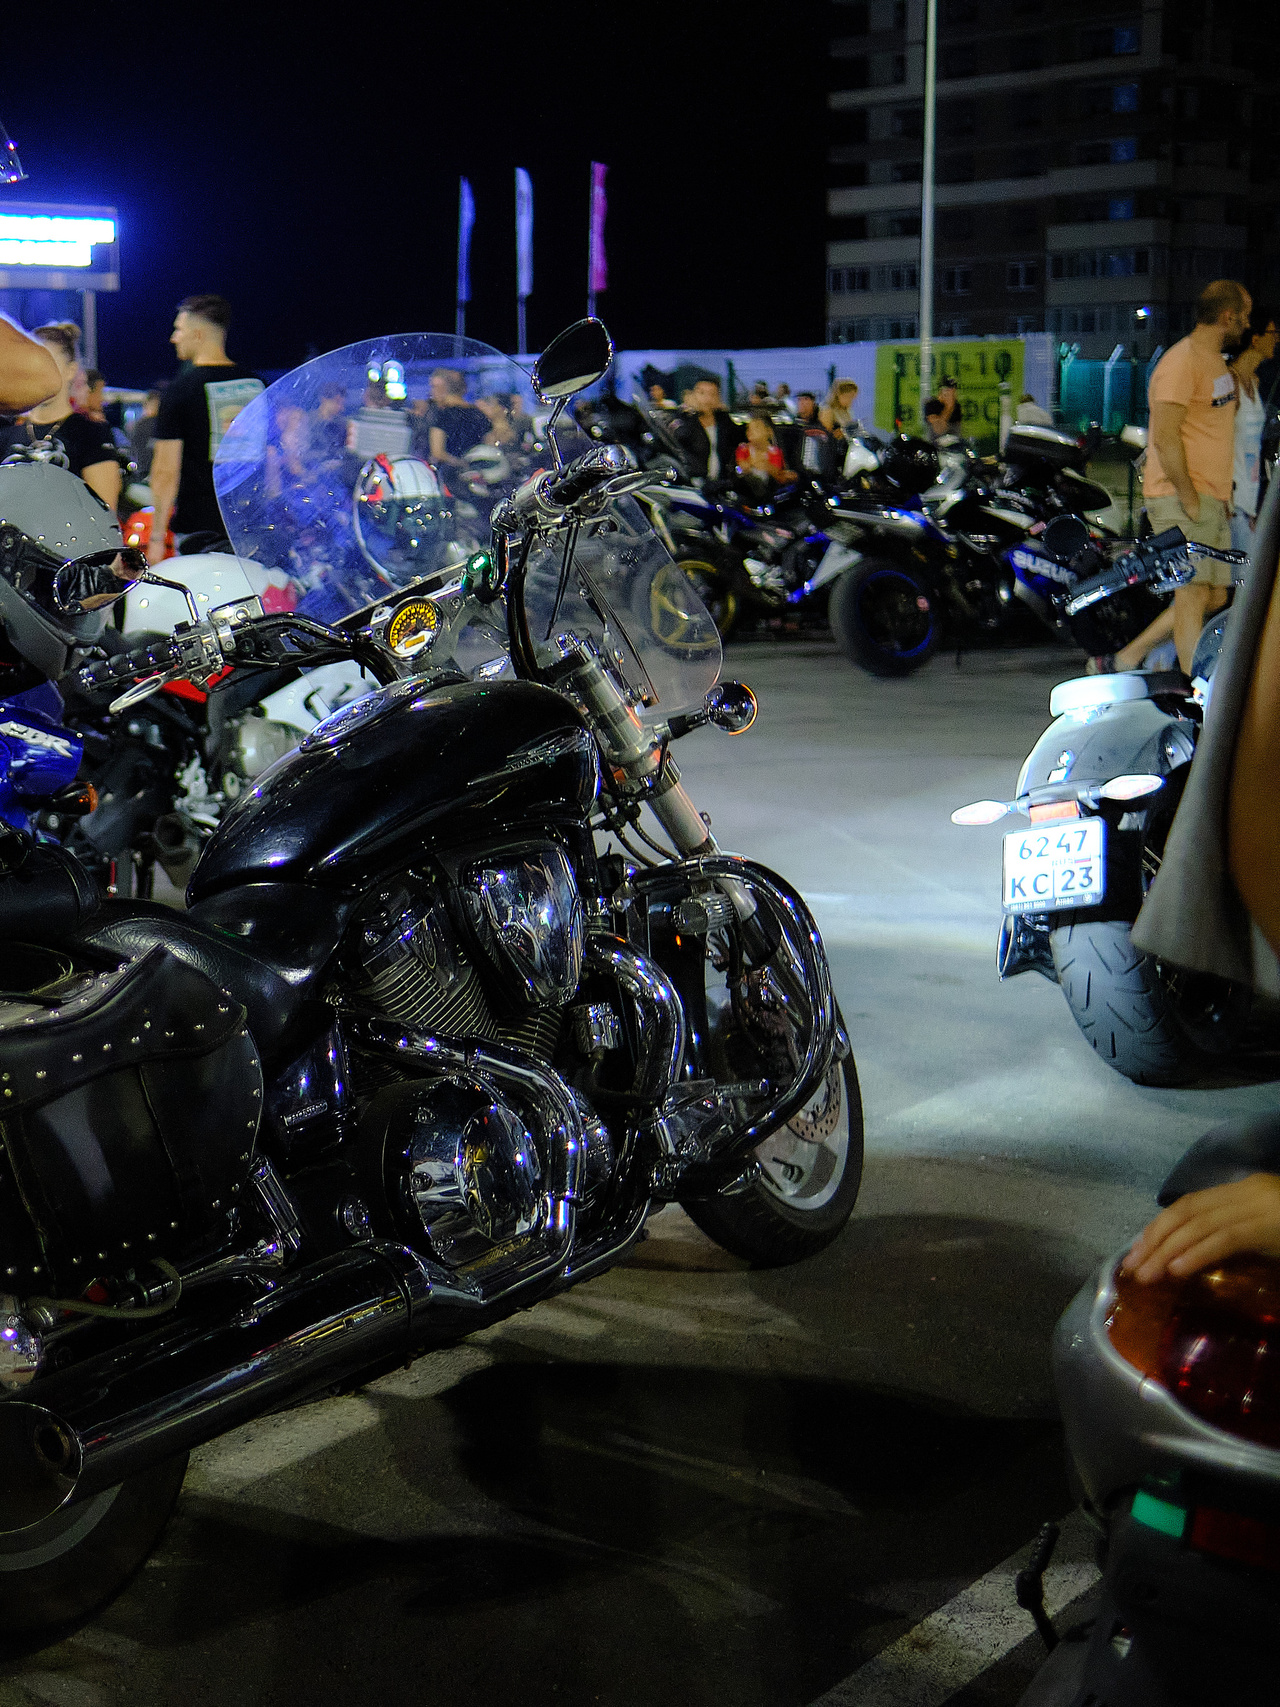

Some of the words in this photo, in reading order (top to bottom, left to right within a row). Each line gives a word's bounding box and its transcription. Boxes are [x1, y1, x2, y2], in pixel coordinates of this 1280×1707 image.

[1019, 829, 1088, 860] 6247
[1011, 873, 1050, 899] KC
[1061, 866, 1093, 892] 23
